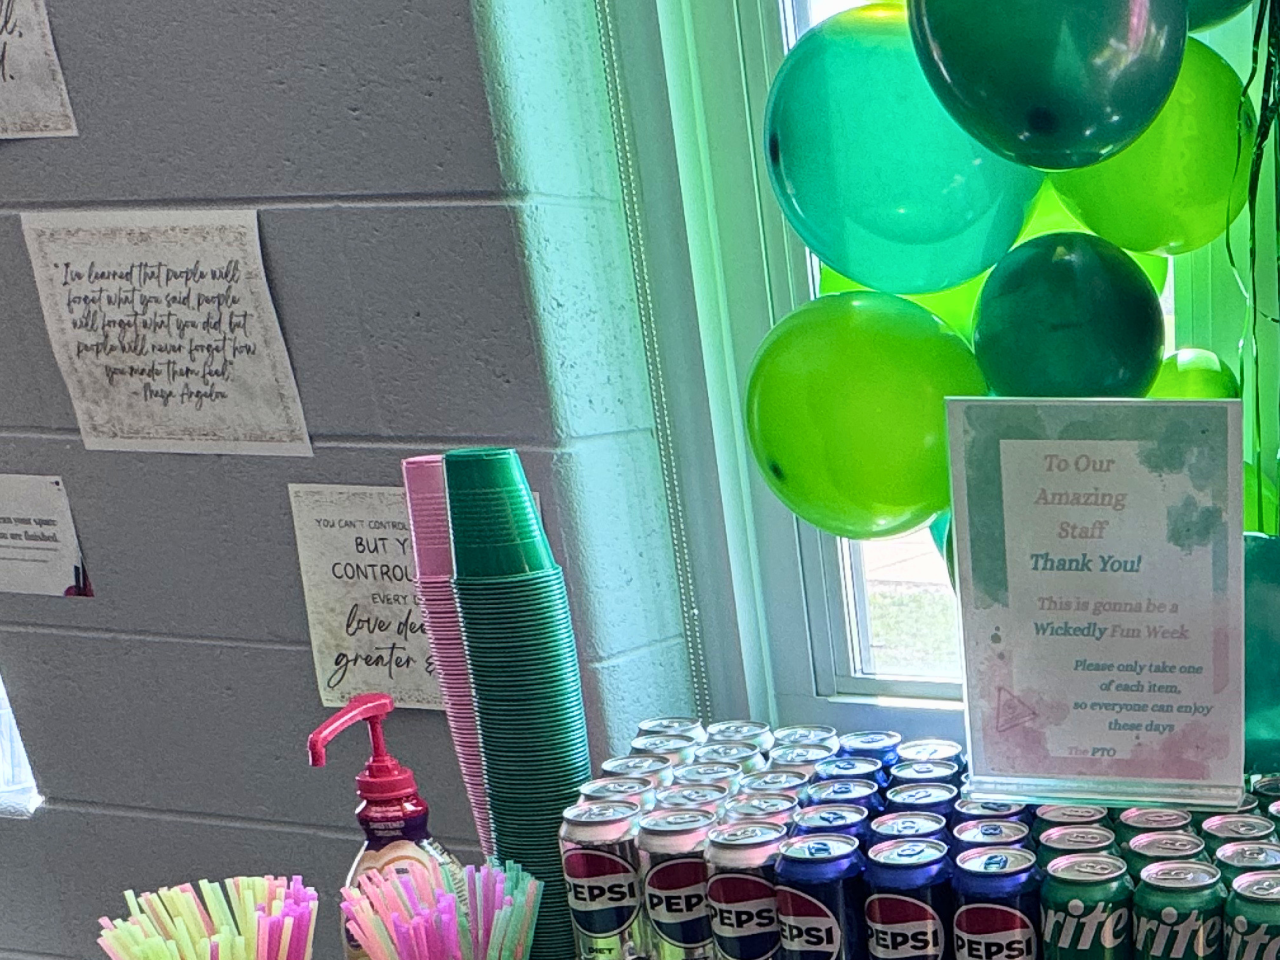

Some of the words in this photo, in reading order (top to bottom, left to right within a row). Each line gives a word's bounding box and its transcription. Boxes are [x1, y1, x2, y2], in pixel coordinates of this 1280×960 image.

[88, 262, 133, 284] learned
[132, 262, 167, 288] that
[165, 261, 207, 287] people
[210, 260, 240, 284] will
[67, 287, 108, 314] forget
[106, 287, 141, 313] what
[140, 294, 162, 314] you
[197, 285, 240, 312] people
[72, 310, 99, 333] will
[101, 311, 143, 341] forget
[142, 311, 178, 337] what
[176, 317, 201, 339] you
[229, 311, 254, 337] but
[76, 335, 118, 359] people
[120, 333, 149, 356] will
[151, 343, 185, 355] never
[188, 332, 232, 365] forget
[105, 364, 130, 386] you
[180, 382, 229, 411] Angelou
[1044, 455, 1069, 472] To
[1074, 454, 1115, 473] Our
[1033, 487, 1128, 511] Amazing
[316, 518, 335, 529] YOU
[368, 520, 409, 531] CONTROL
[1057, 520, 1109, 540] Staff
[354, 536, 389, 554] BUT
[331, 561, 413, 583] CONTROL
[1030, 553, 1093, 573] Thank
[1099, 554, 1142, 573] You!
[371, 593, 409, 606] EVERY
[1037, 597, 1072, 613] This
[1076, 598, 1090, 613] is
[1092, 600, 1143, 616] gonna
[1148, 598, 1167, 614] be
[1169, 603, 1179, 614] a
[345, 603, 392, 637] love
[1033, 622, 1108, 641] Wickedly
[1109, 624, 1141, 639] Fun
[1147, 624, 1190, 640] Week
[326, 641, 418, 690] greater
[1073, 659, 1115, 672] Please
[1117, 660, 1147, 675] only
[1149, 661, 1177, 674] take
[1179, 664, 1204, 675] one
[1099, 679, 1114, 692] of
[1115, 680, 1144, 693] each
[1073, 701, 1087, 711] so
[1090, 702, 1149, 714] everyone
[1151, 703, 1174, 713] can
[1176, 702, 1214, 717] enjoy
[1108, 719, 1143, 732] these
[1145, 720, 1176, 735] days
[1068, 746, 1090, 756] The
[1091, 746, 1117, 757] PTO
[648, 893, 706, 914] PEP
[711, 904, 776, 929] PEPS
[1041, 898, 1129, 950] rite
[780, 921, 834, 946] EPSI
[1132, 906, 1221, 959] rite
[955, 933, 1032, 960] PEPSI
